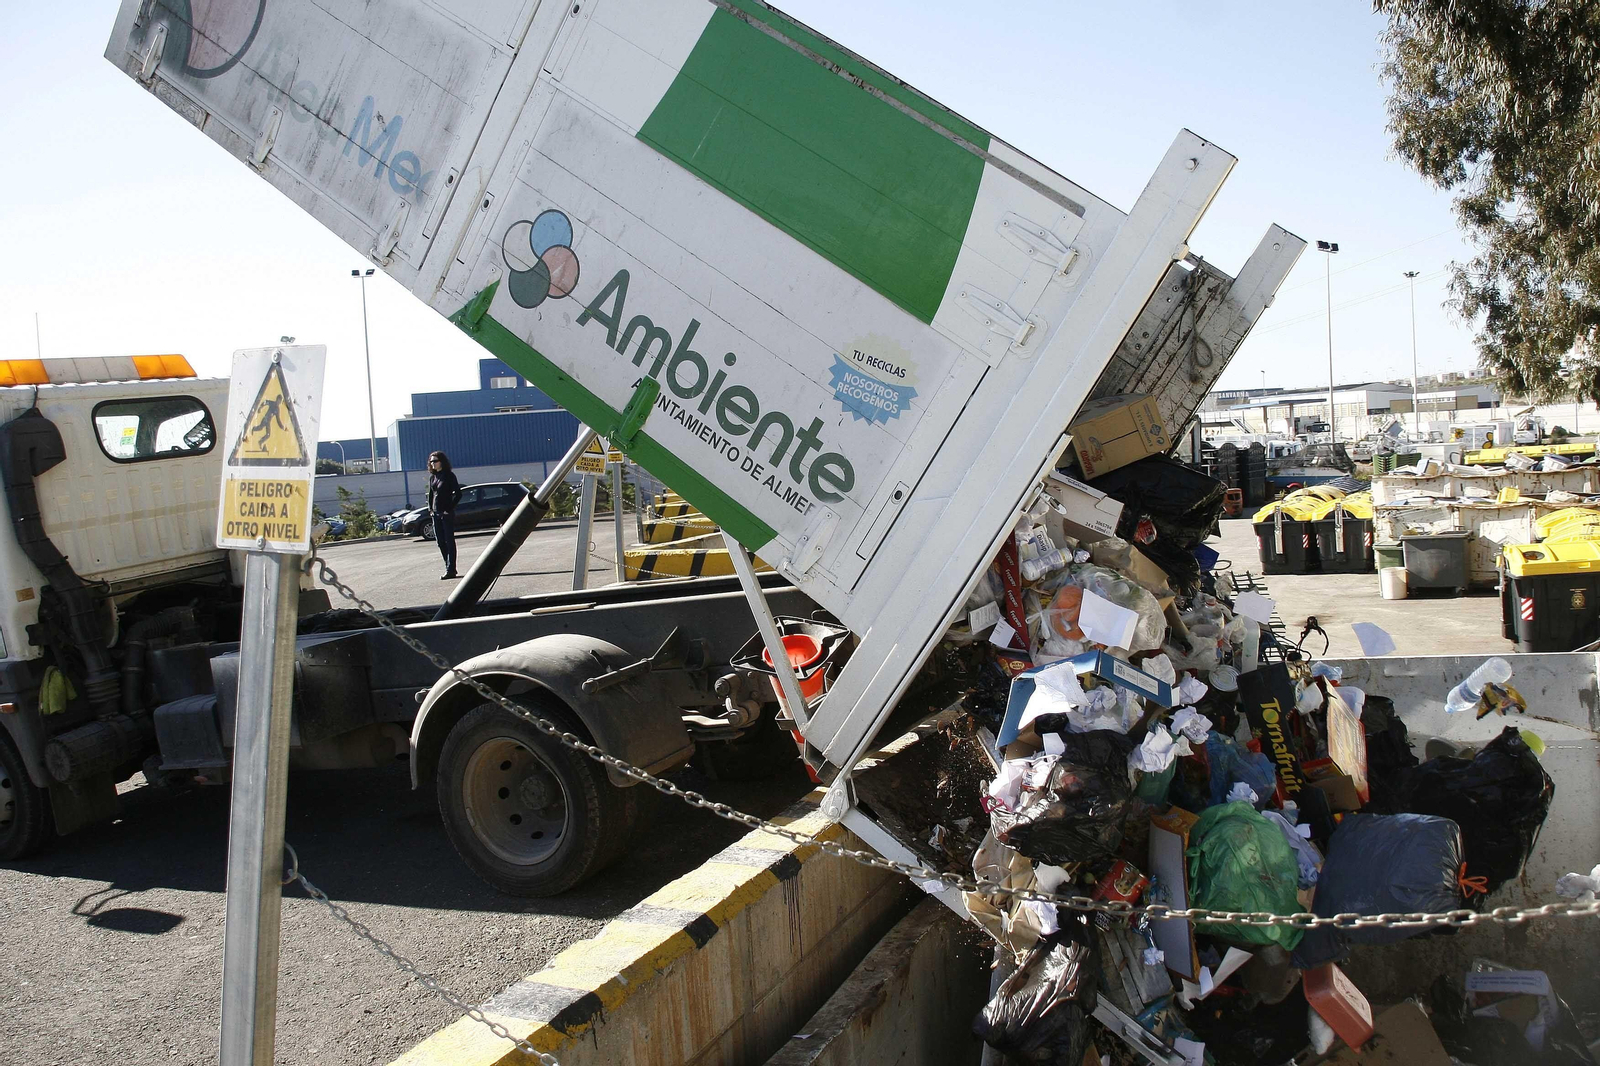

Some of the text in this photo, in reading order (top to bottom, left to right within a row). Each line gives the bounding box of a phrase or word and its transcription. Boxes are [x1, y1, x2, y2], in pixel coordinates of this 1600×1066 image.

[853, 349, 907, 379] TU RECICLAS
[575, 268, 856, 505] Ambiente
[836, 381, 899, 414] RECOGEMOS
[843, 372, 899, 402] NOSOTROS
[740, 455, 765, 481] DE
[239, 482, 293, 498] PELIGRO
[240, 501, 289, 518] CAIDA A
[226, 520, 300, 539] OTRO NIVEL
[1260, 697, 1303, 794] Tornafruit
